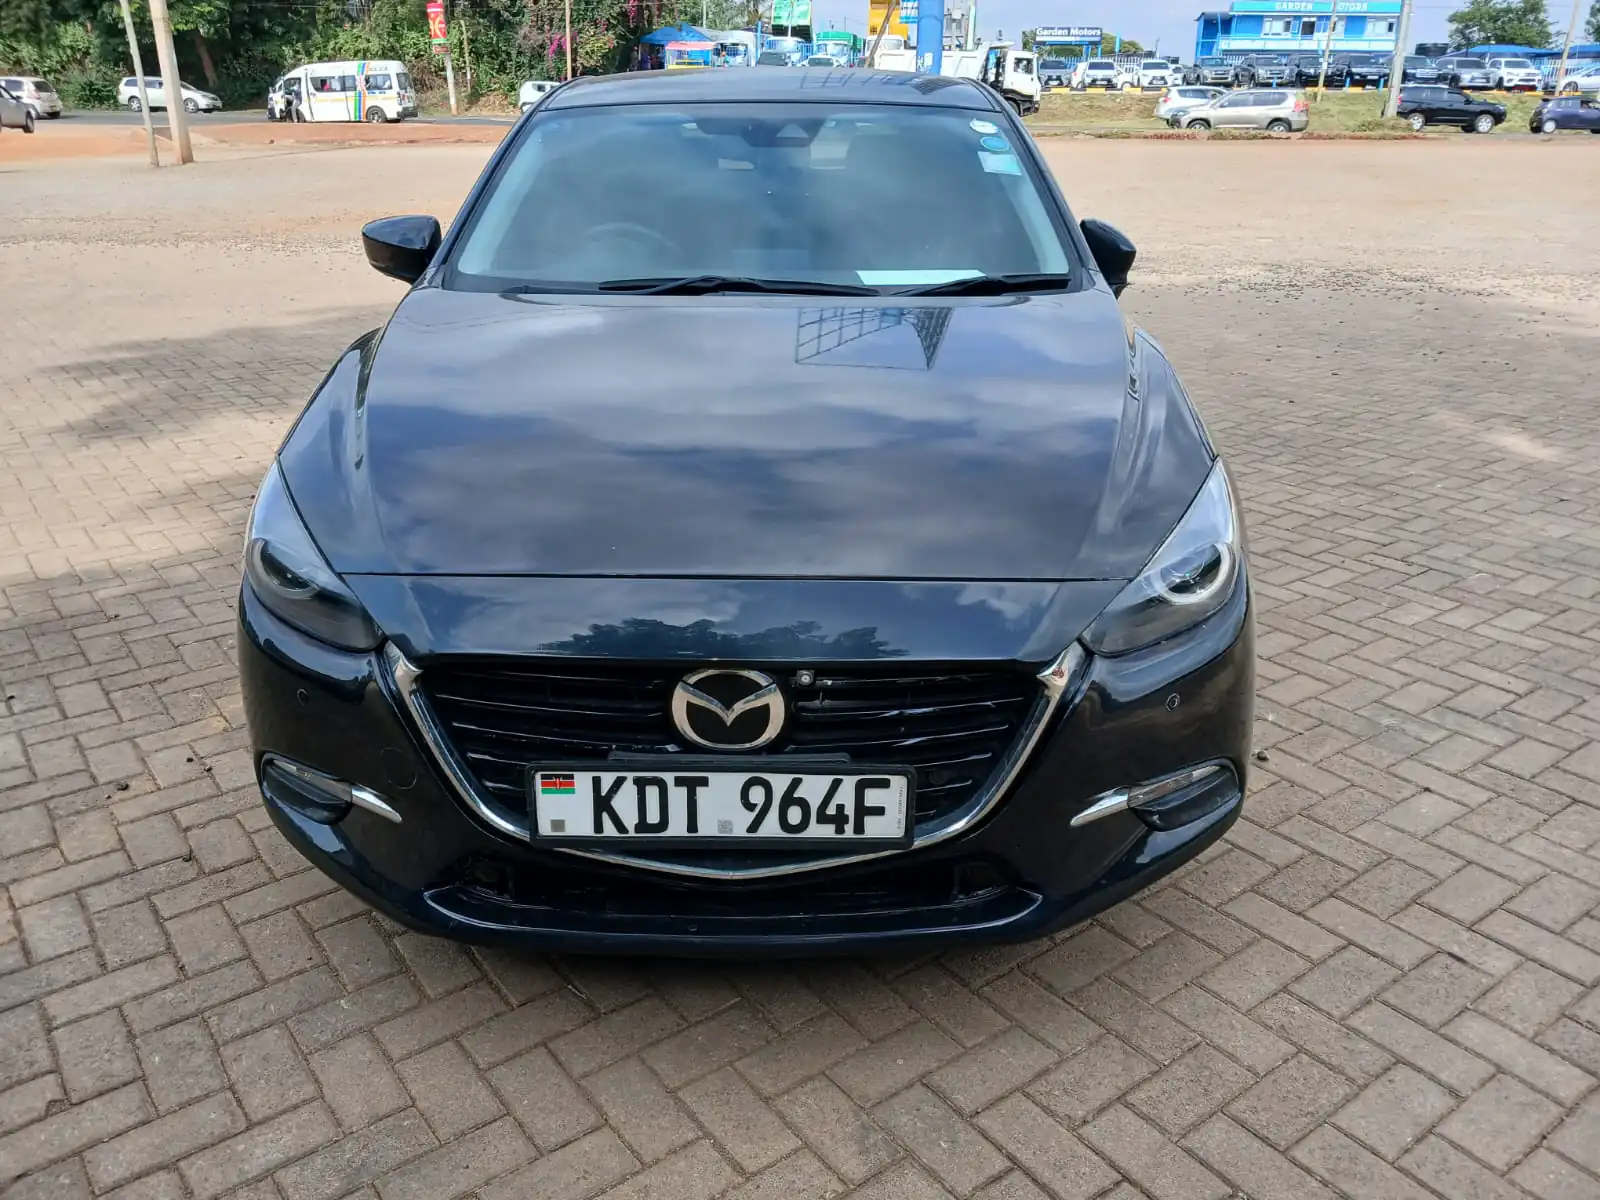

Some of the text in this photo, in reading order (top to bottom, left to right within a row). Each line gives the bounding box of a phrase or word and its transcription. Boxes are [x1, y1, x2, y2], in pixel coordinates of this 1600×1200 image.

[1036, 27, 1101, 36] Garden Motors
[592, 776, 708, 834] KDT
[740, 777, 891, 835] 964F
